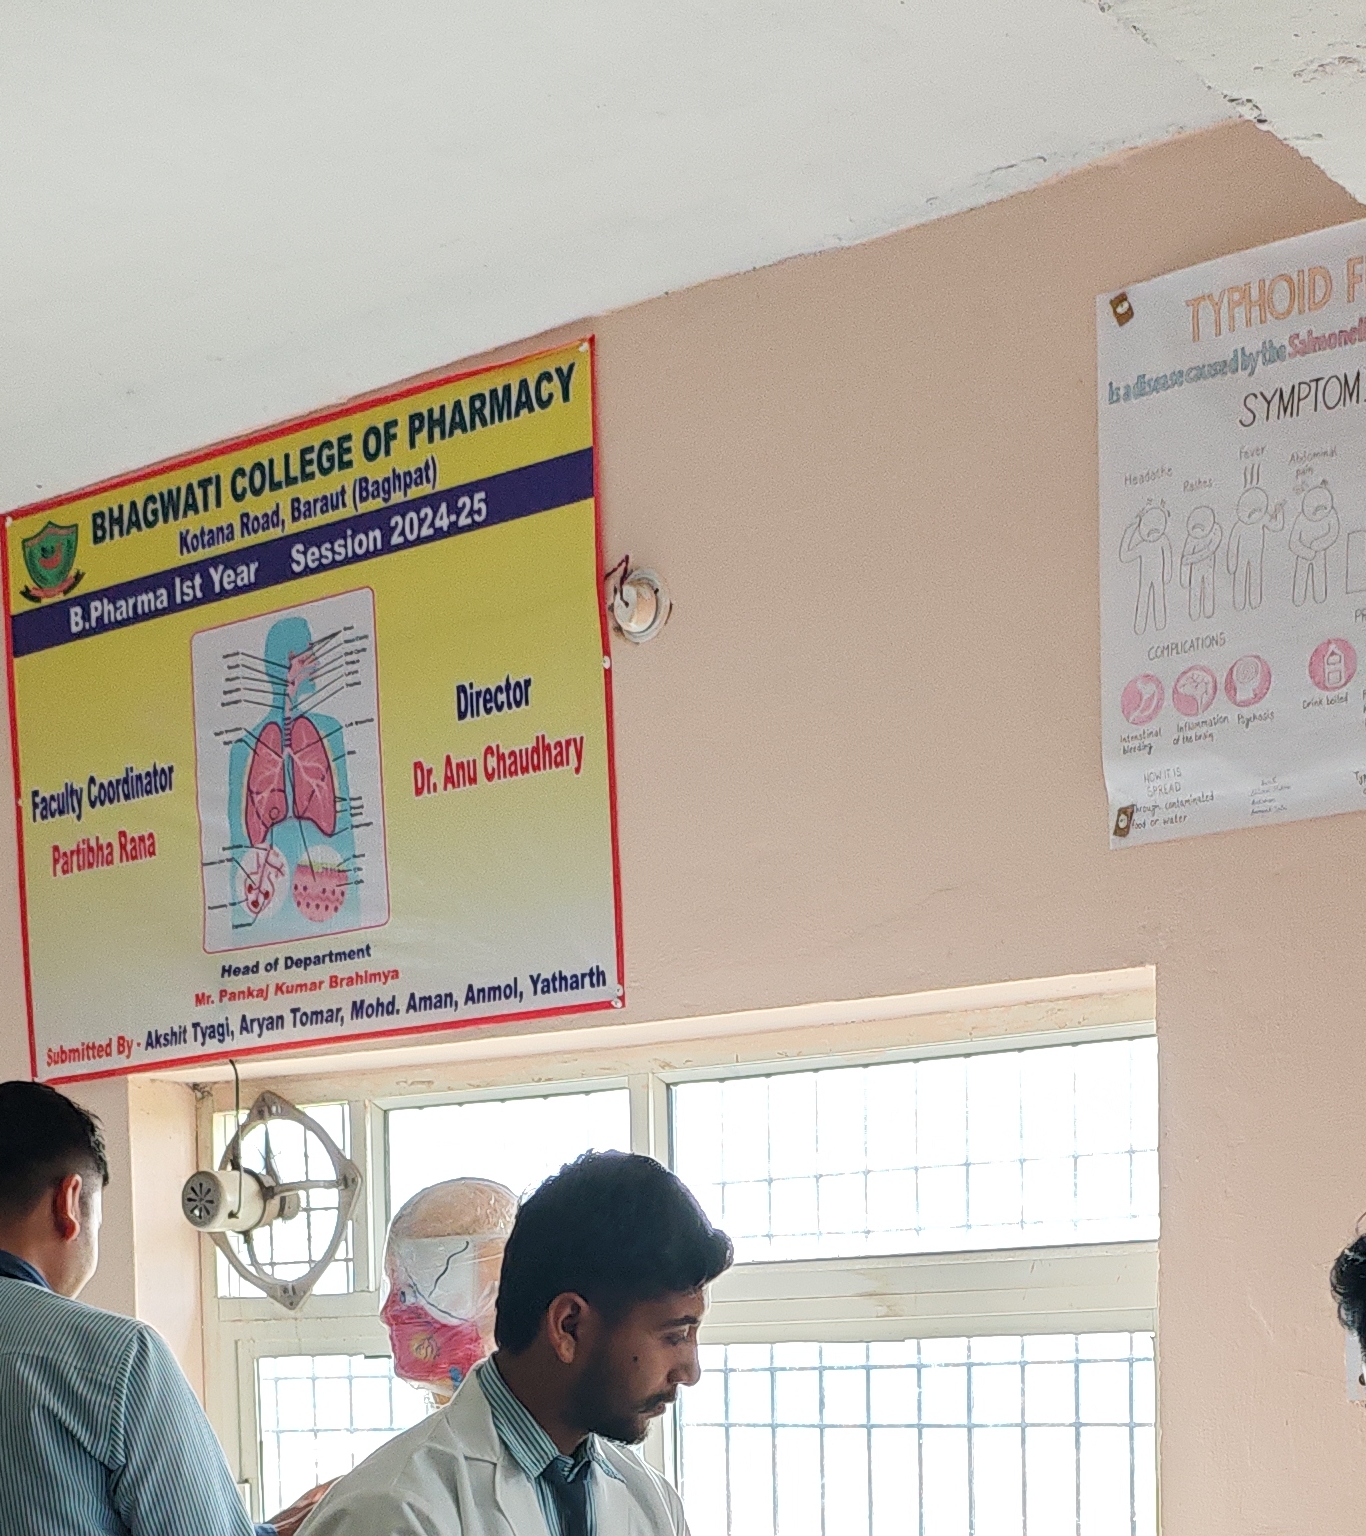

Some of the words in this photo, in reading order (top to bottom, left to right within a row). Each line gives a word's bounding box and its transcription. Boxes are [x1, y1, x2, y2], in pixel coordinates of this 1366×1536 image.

[1186, 265, 1333, 343] TYPHOID
[1185, 348, 1239, 383] caused
[1241, 346, 1259, 377] by
[1261, 339, 1287, 367] the
[91, 477, 222, 546] BHAGWATI
[231, 432, 354, 504] COLLEGE
[362, 418, 399, 463] OF
[408, 362, 576, 450] PHARMACY
[1239, 444, 1267, 461] Fever
[178, 520, 235, 557] Kotana
[239, 501, 286, 539] Road,
[290, 488, 348, 524] Baraut
[352, 454, 438, 513] (Baghpat)
[68, 590, 170, 634] B.Pharma
[207, 561, 259, 595] Year
[290, 526, 383, 574] Session
[389, 491, 488, 547] 2024-25
[1147, 631, 1227, 661] COMPLICATIONS
[455, 673, 532, 722] Director
[412, 759, 438, 798] Dr.
[442, 753, 478, 792] Anu
[482, 733, 585, 783] Chaudhary
[1143, 771, 1162, 784] HOW
[1163, 768, 1171, 781] IT
[1173, 766, 1183, 779] IS
[1146, 781, 1181, 798] SPREAD
[31, 781, 84, 823] Faculty
[87, 761, 175, 810] Coordinator
[51, 835, 115, 878] Partibha
[117, 829, 157, 864] Rana
[220, 960, 260, 979] Head
[263, 956, 280, 974] of
[283, 943, 372, 972] Department
[193, 991, 215, 1008] Mr.
[217, 983, 270, 1004] Pankaj
[273, 979, 325, 998] Kumar
[328, 967, 400, 990] Brahimya
[46, 1036, 113, 1068] Submitted
[116, 1034, 134, 1060] By
[144, 1024, 188, 1051] Akshit
[191, 1015, 235, 1047] Tyagi,
[238, 1012, 285, 1039] Aryan
[289, 1005, 346, 1029] Tomar,
[349, 994, 400, 1021] Mohd.
[405, 990, 459, 1013] Aman,
[463, 976, 524, 1006] Anmol,
[528, 964, 607, 997] Yatharth
